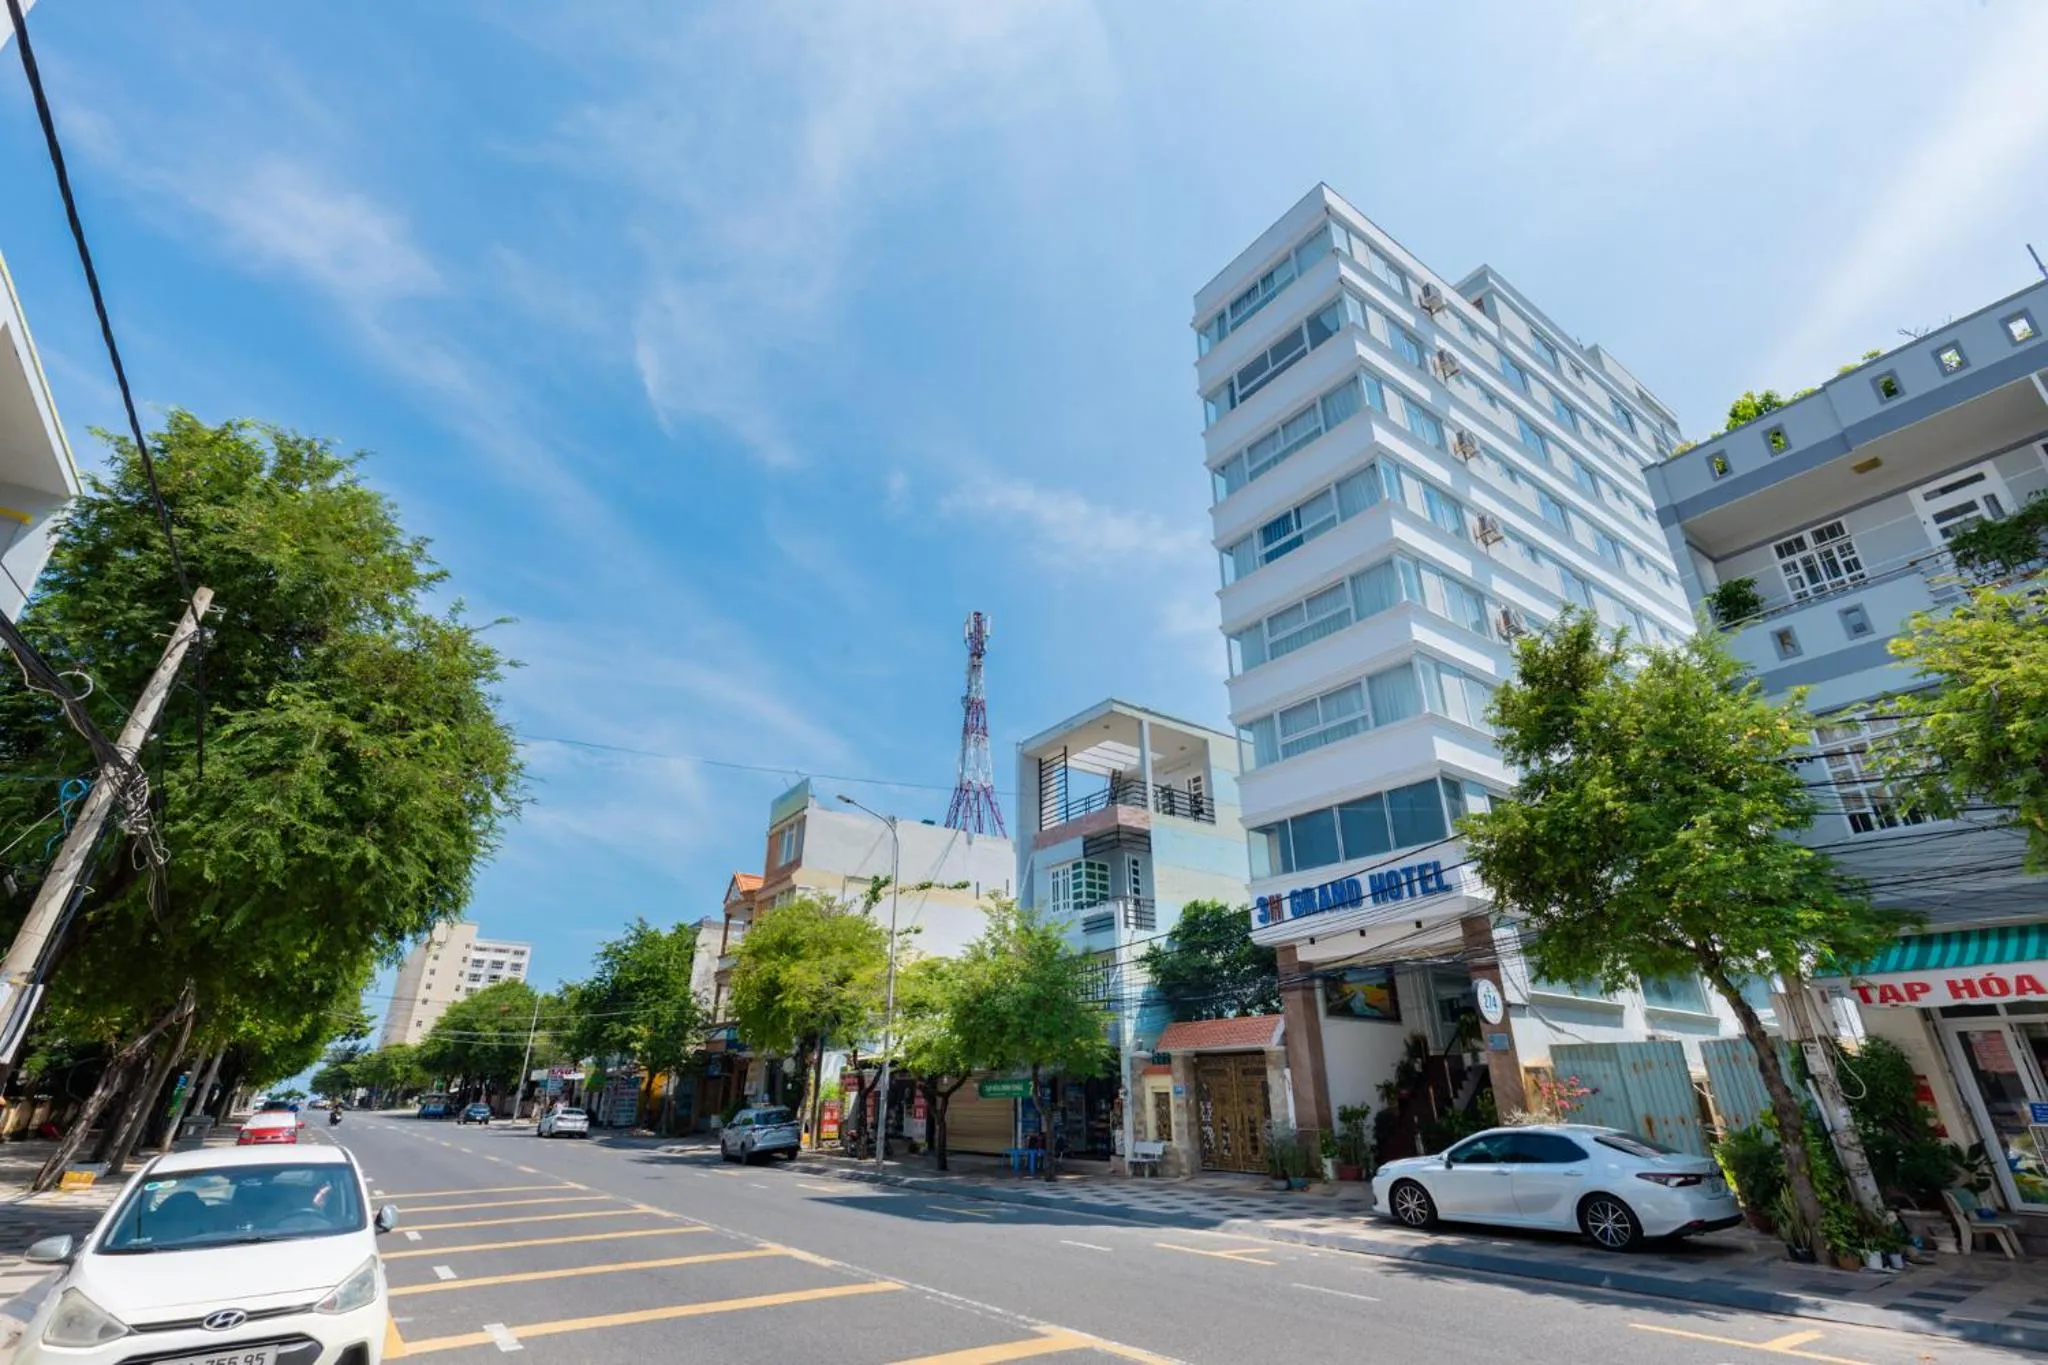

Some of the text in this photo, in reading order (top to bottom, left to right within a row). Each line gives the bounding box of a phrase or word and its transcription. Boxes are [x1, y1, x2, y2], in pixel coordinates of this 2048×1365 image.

[1256, 861, 1453, 924] 3H GRAND HOTEL
[1945, 972, 2048, 1000] HÓA
